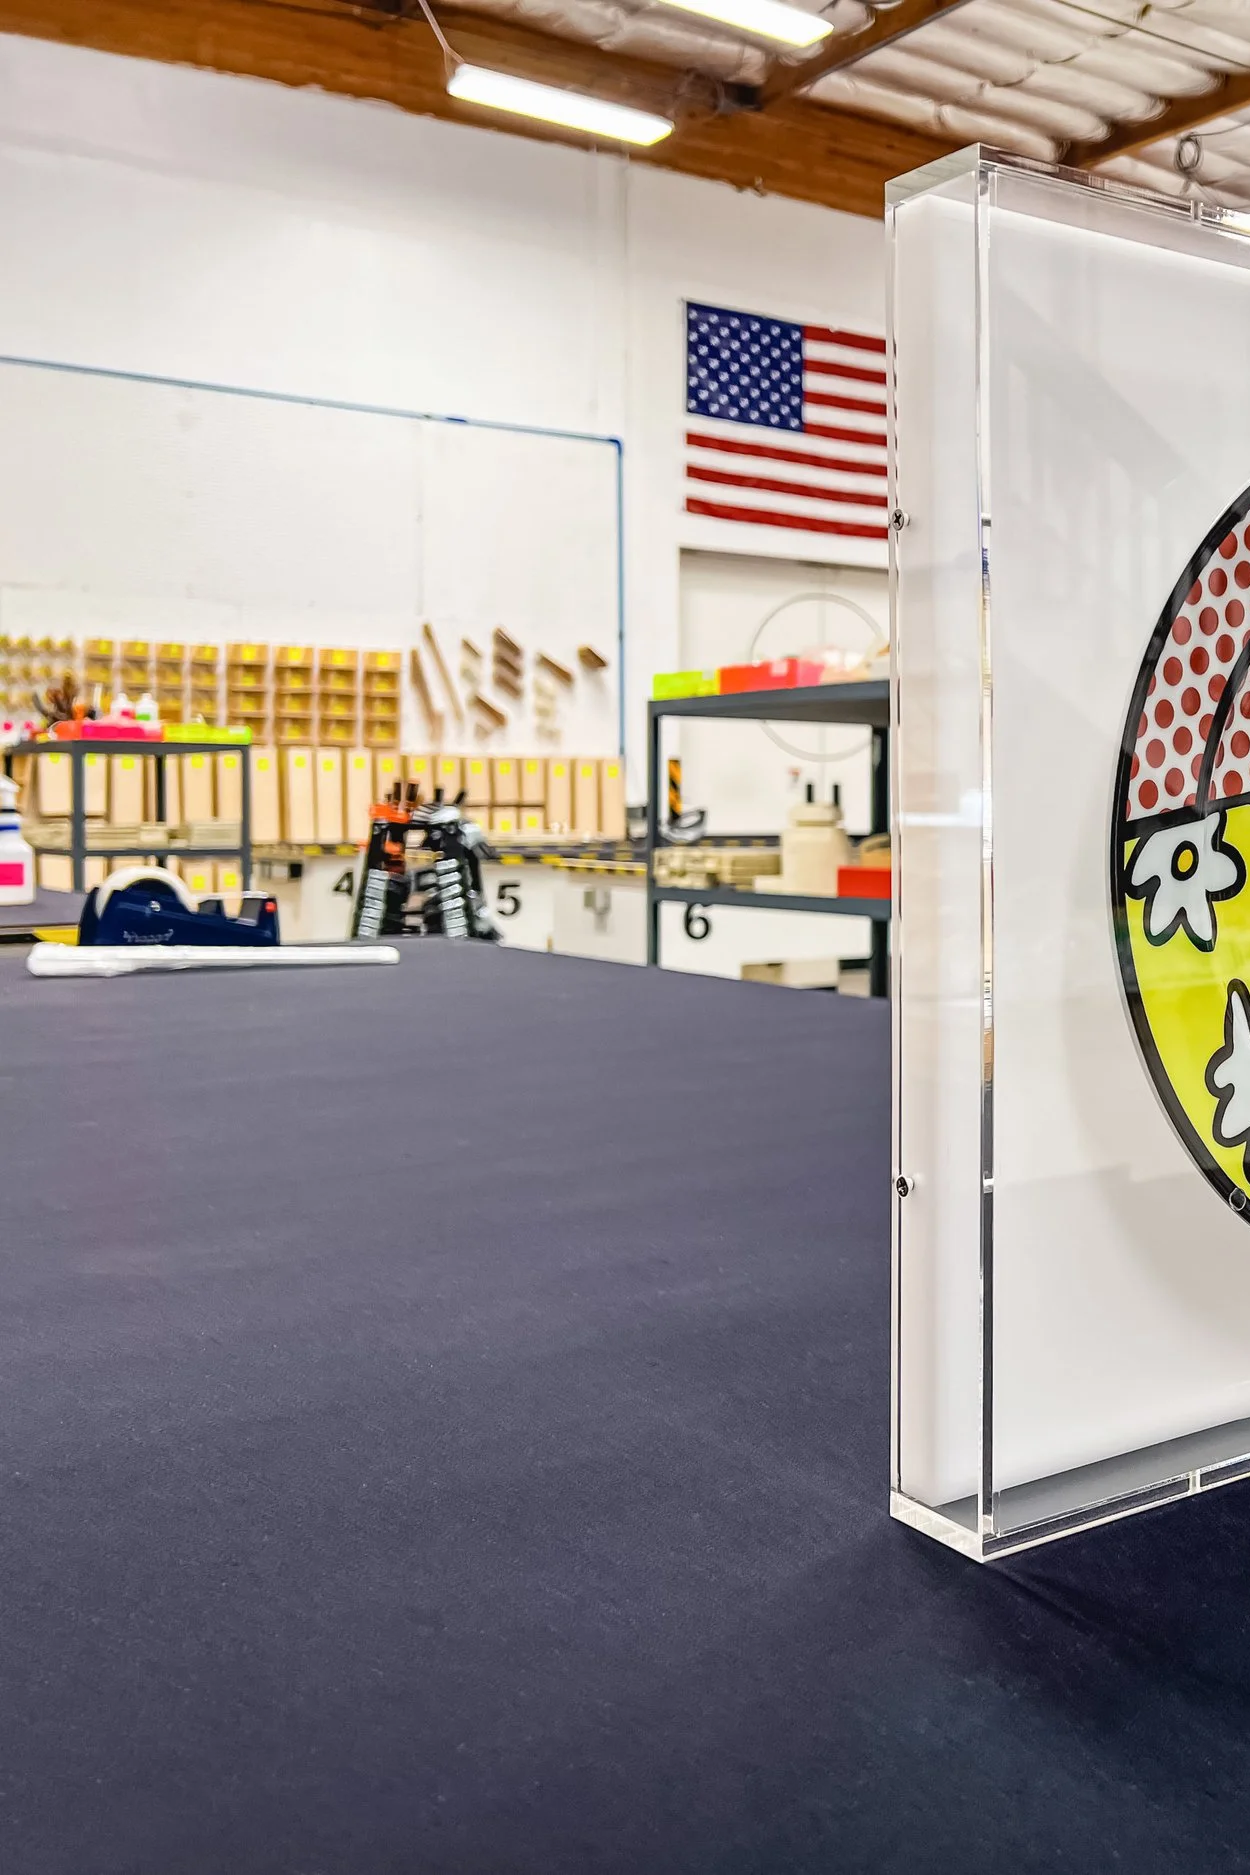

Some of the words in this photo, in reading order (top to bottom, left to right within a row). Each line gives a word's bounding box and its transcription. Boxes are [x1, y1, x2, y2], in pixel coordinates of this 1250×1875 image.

[333, 870, 353, 897] 4
[497, 883, 521, 917] 5
[685, 901, 710, 940] 6
